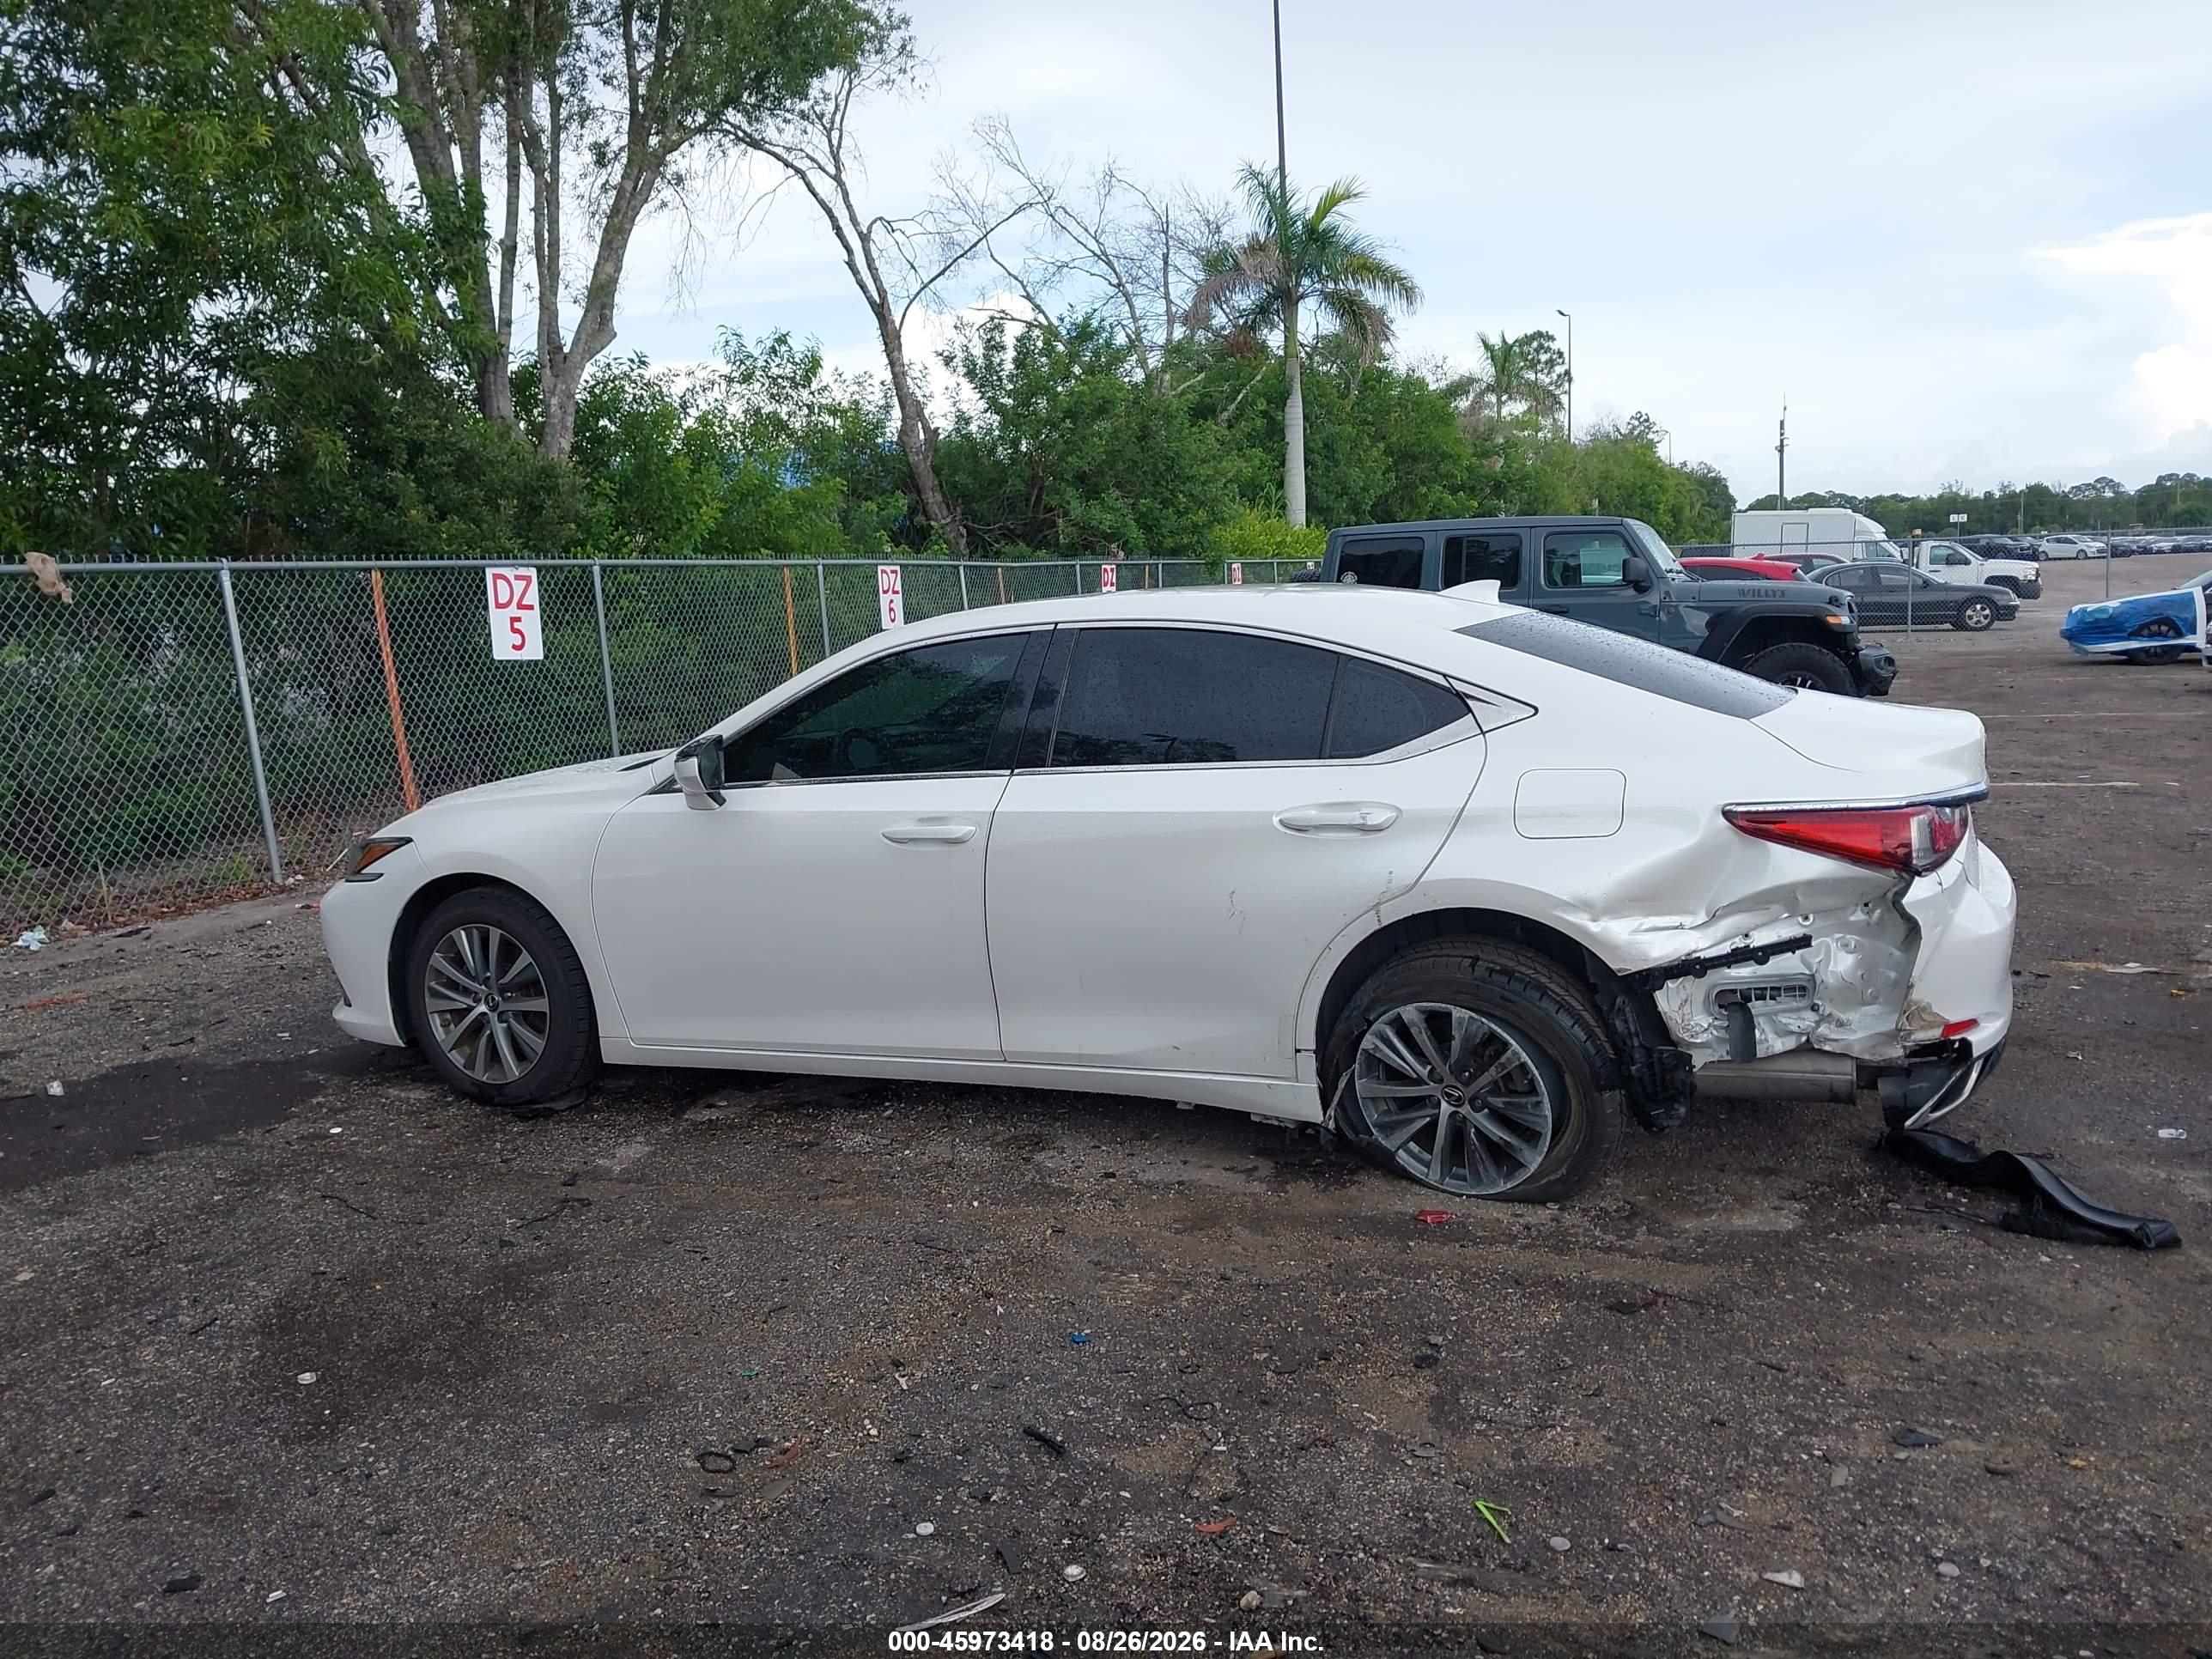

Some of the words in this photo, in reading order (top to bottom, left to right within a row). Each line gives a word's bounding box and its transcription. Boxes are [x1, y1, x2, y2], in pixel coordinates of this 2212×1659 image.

[880, 569, 900, 594] DZ
[1103, 568, 1115, 587] DZ
[491, 573, 534, 611] DZ
[1738, 588, 1786, 599] WILLYS
[888, 599, 896, 623] 6
[509, 617, 526, 651] 5
